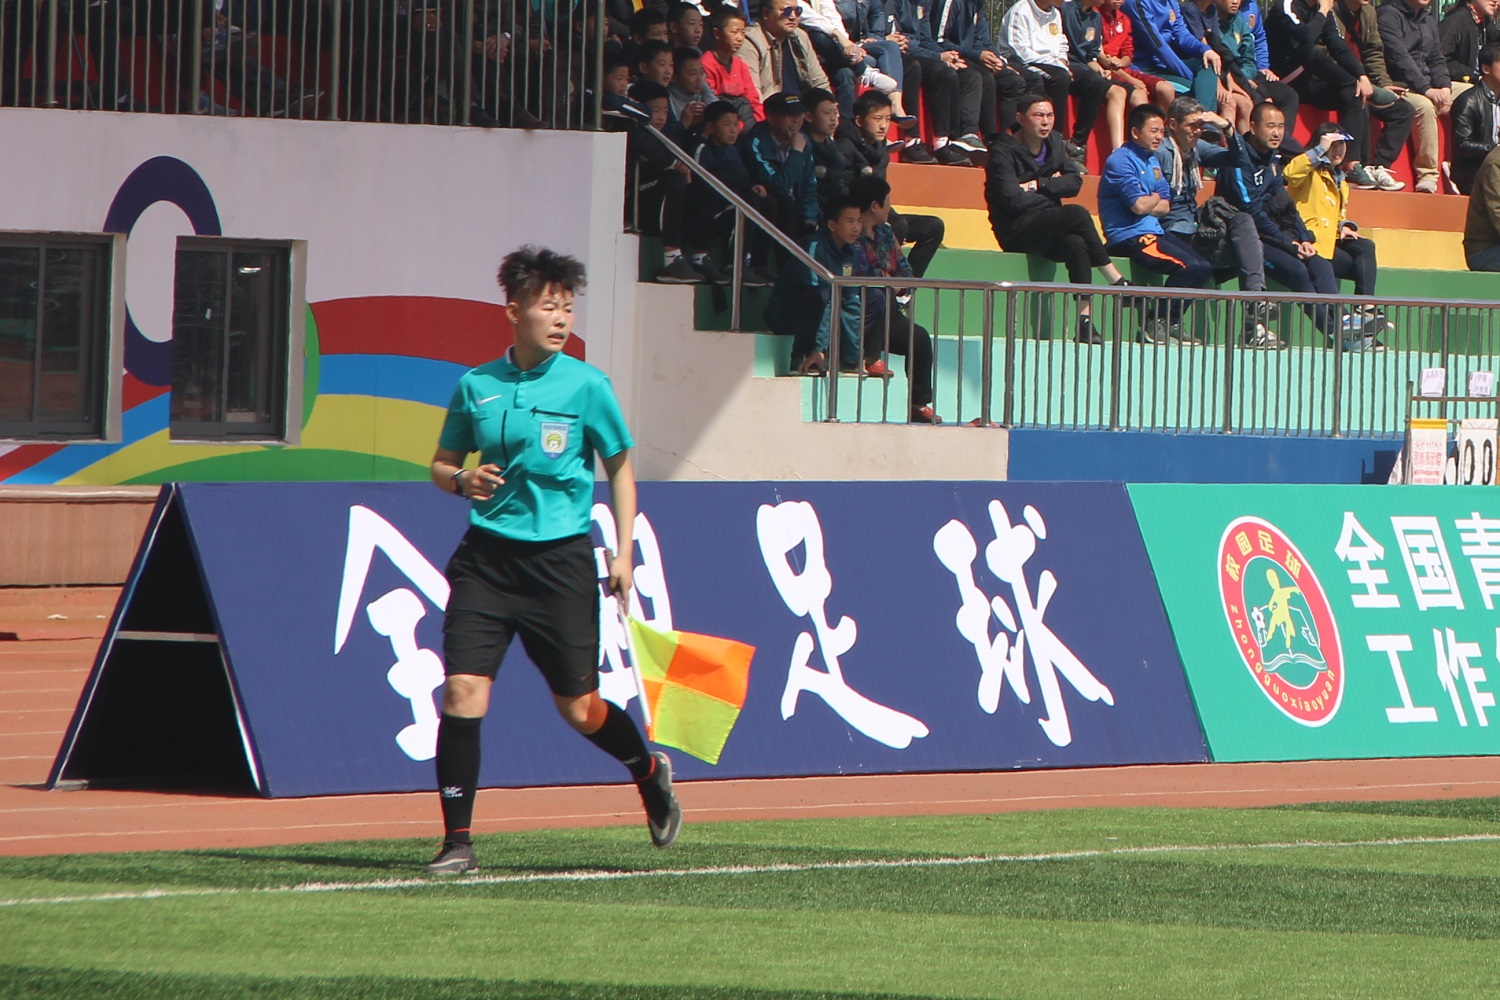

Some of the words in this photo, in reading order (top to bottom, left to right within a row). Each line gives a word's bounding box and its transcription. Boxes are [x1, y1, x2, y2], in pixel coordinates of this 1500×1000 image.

[1225, 529, 1302, 582] 校园足球
[1231, 604, 1335, 711] zhongguoxiaoyuan
